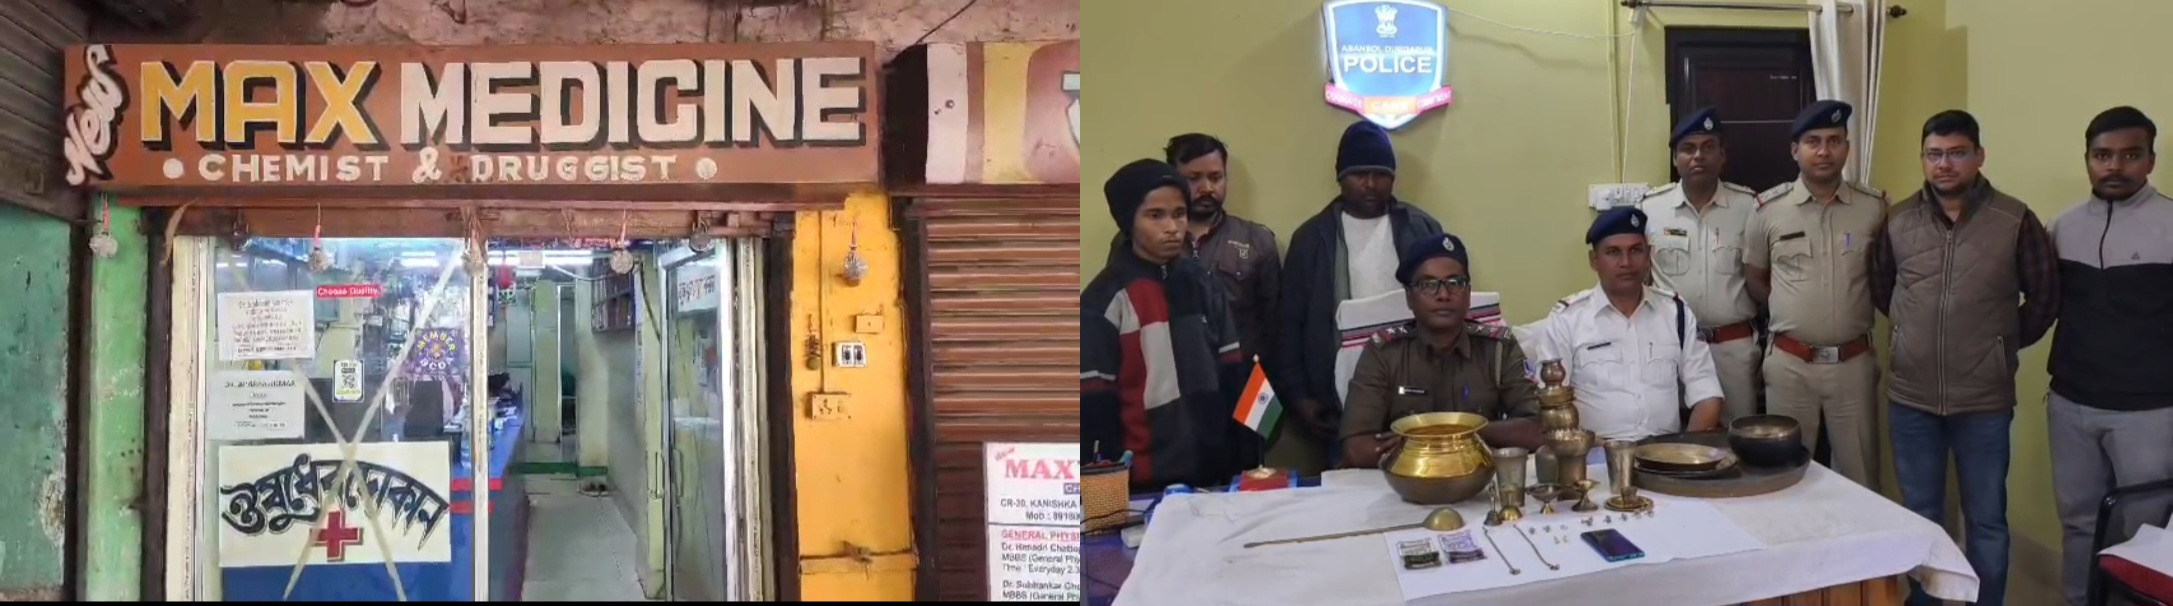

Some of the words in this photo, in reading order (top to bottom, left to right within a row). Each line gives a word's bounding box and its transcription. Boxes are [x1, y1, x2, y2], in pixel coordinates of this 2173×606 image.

[1343, 55, 1433, 73] POLICE
[141, 60, 382, 148] MAX
[400, 57, 863, 147] MEDICINE
[64, 45, 124, 186] New
[198, 153, 388, 183] CHEMIST
[411, 145, 443, 184] &
[470, 154, 676, 182] DRUGGIST
[317, 286, 348, 297] Choose
[417, 330, 456, 351] MEMBER
[1005, 459, 1075, 479] MAX
[1030, 499, 1077, 509] KANISHKA
[1001, 529, 1047, 541] GENERAL
[1028, 564, 1065, 576] Everyday
